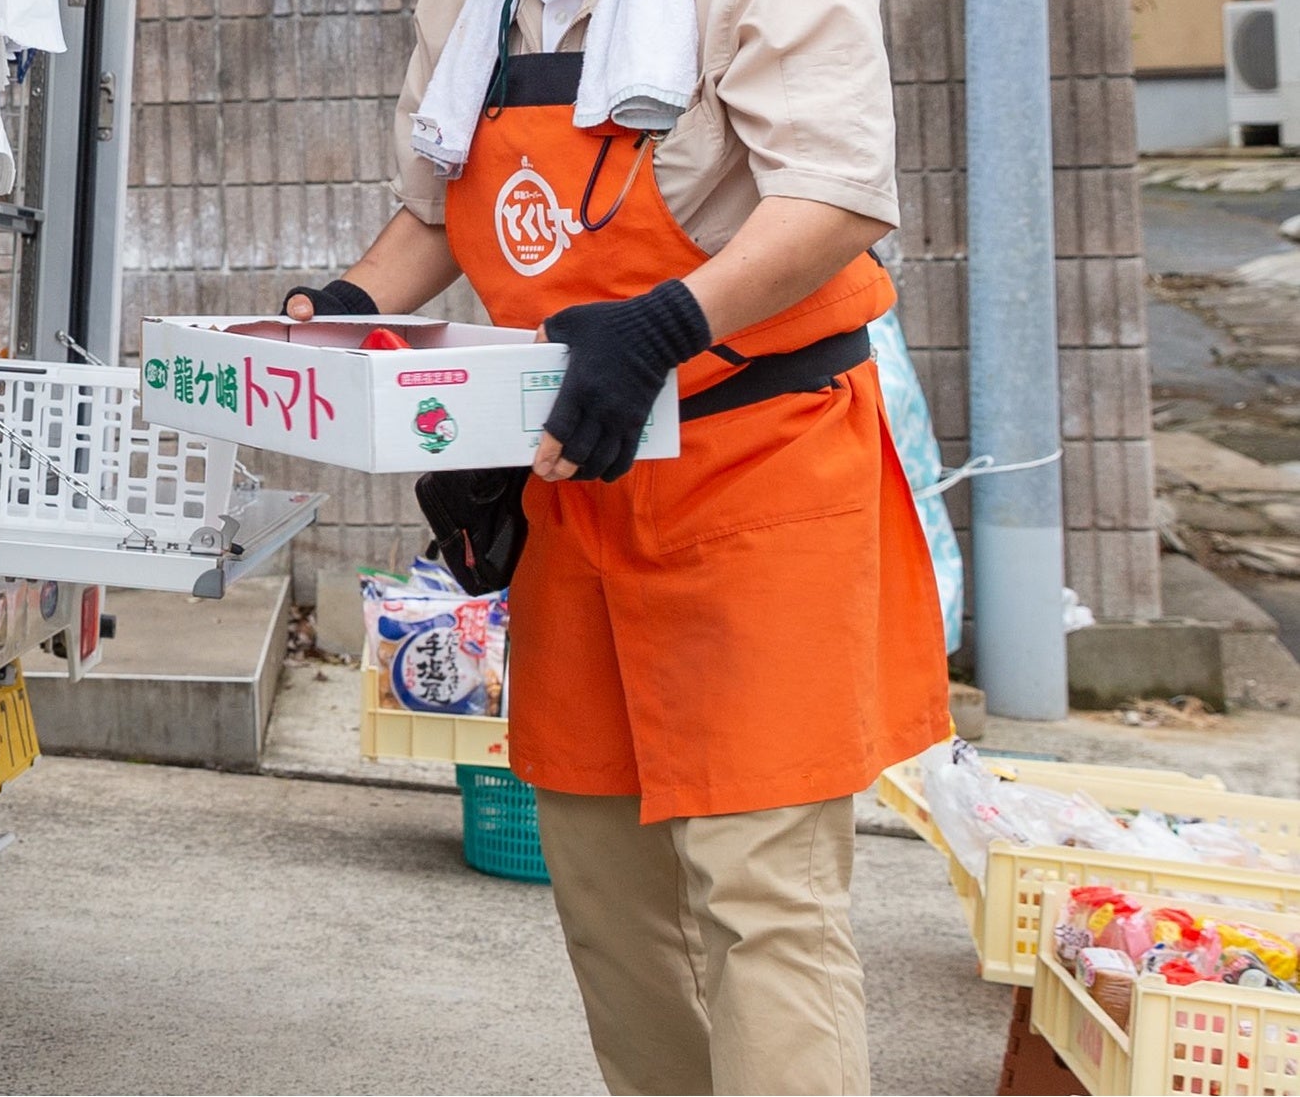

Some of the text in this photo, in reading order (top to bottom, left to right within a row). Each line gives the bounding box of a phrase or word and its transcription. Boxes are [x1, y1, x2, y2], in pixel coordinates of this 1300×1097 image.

[502, 202, 584, 249] とくし丸
[416, 632, 451, 705] 手塩屋
